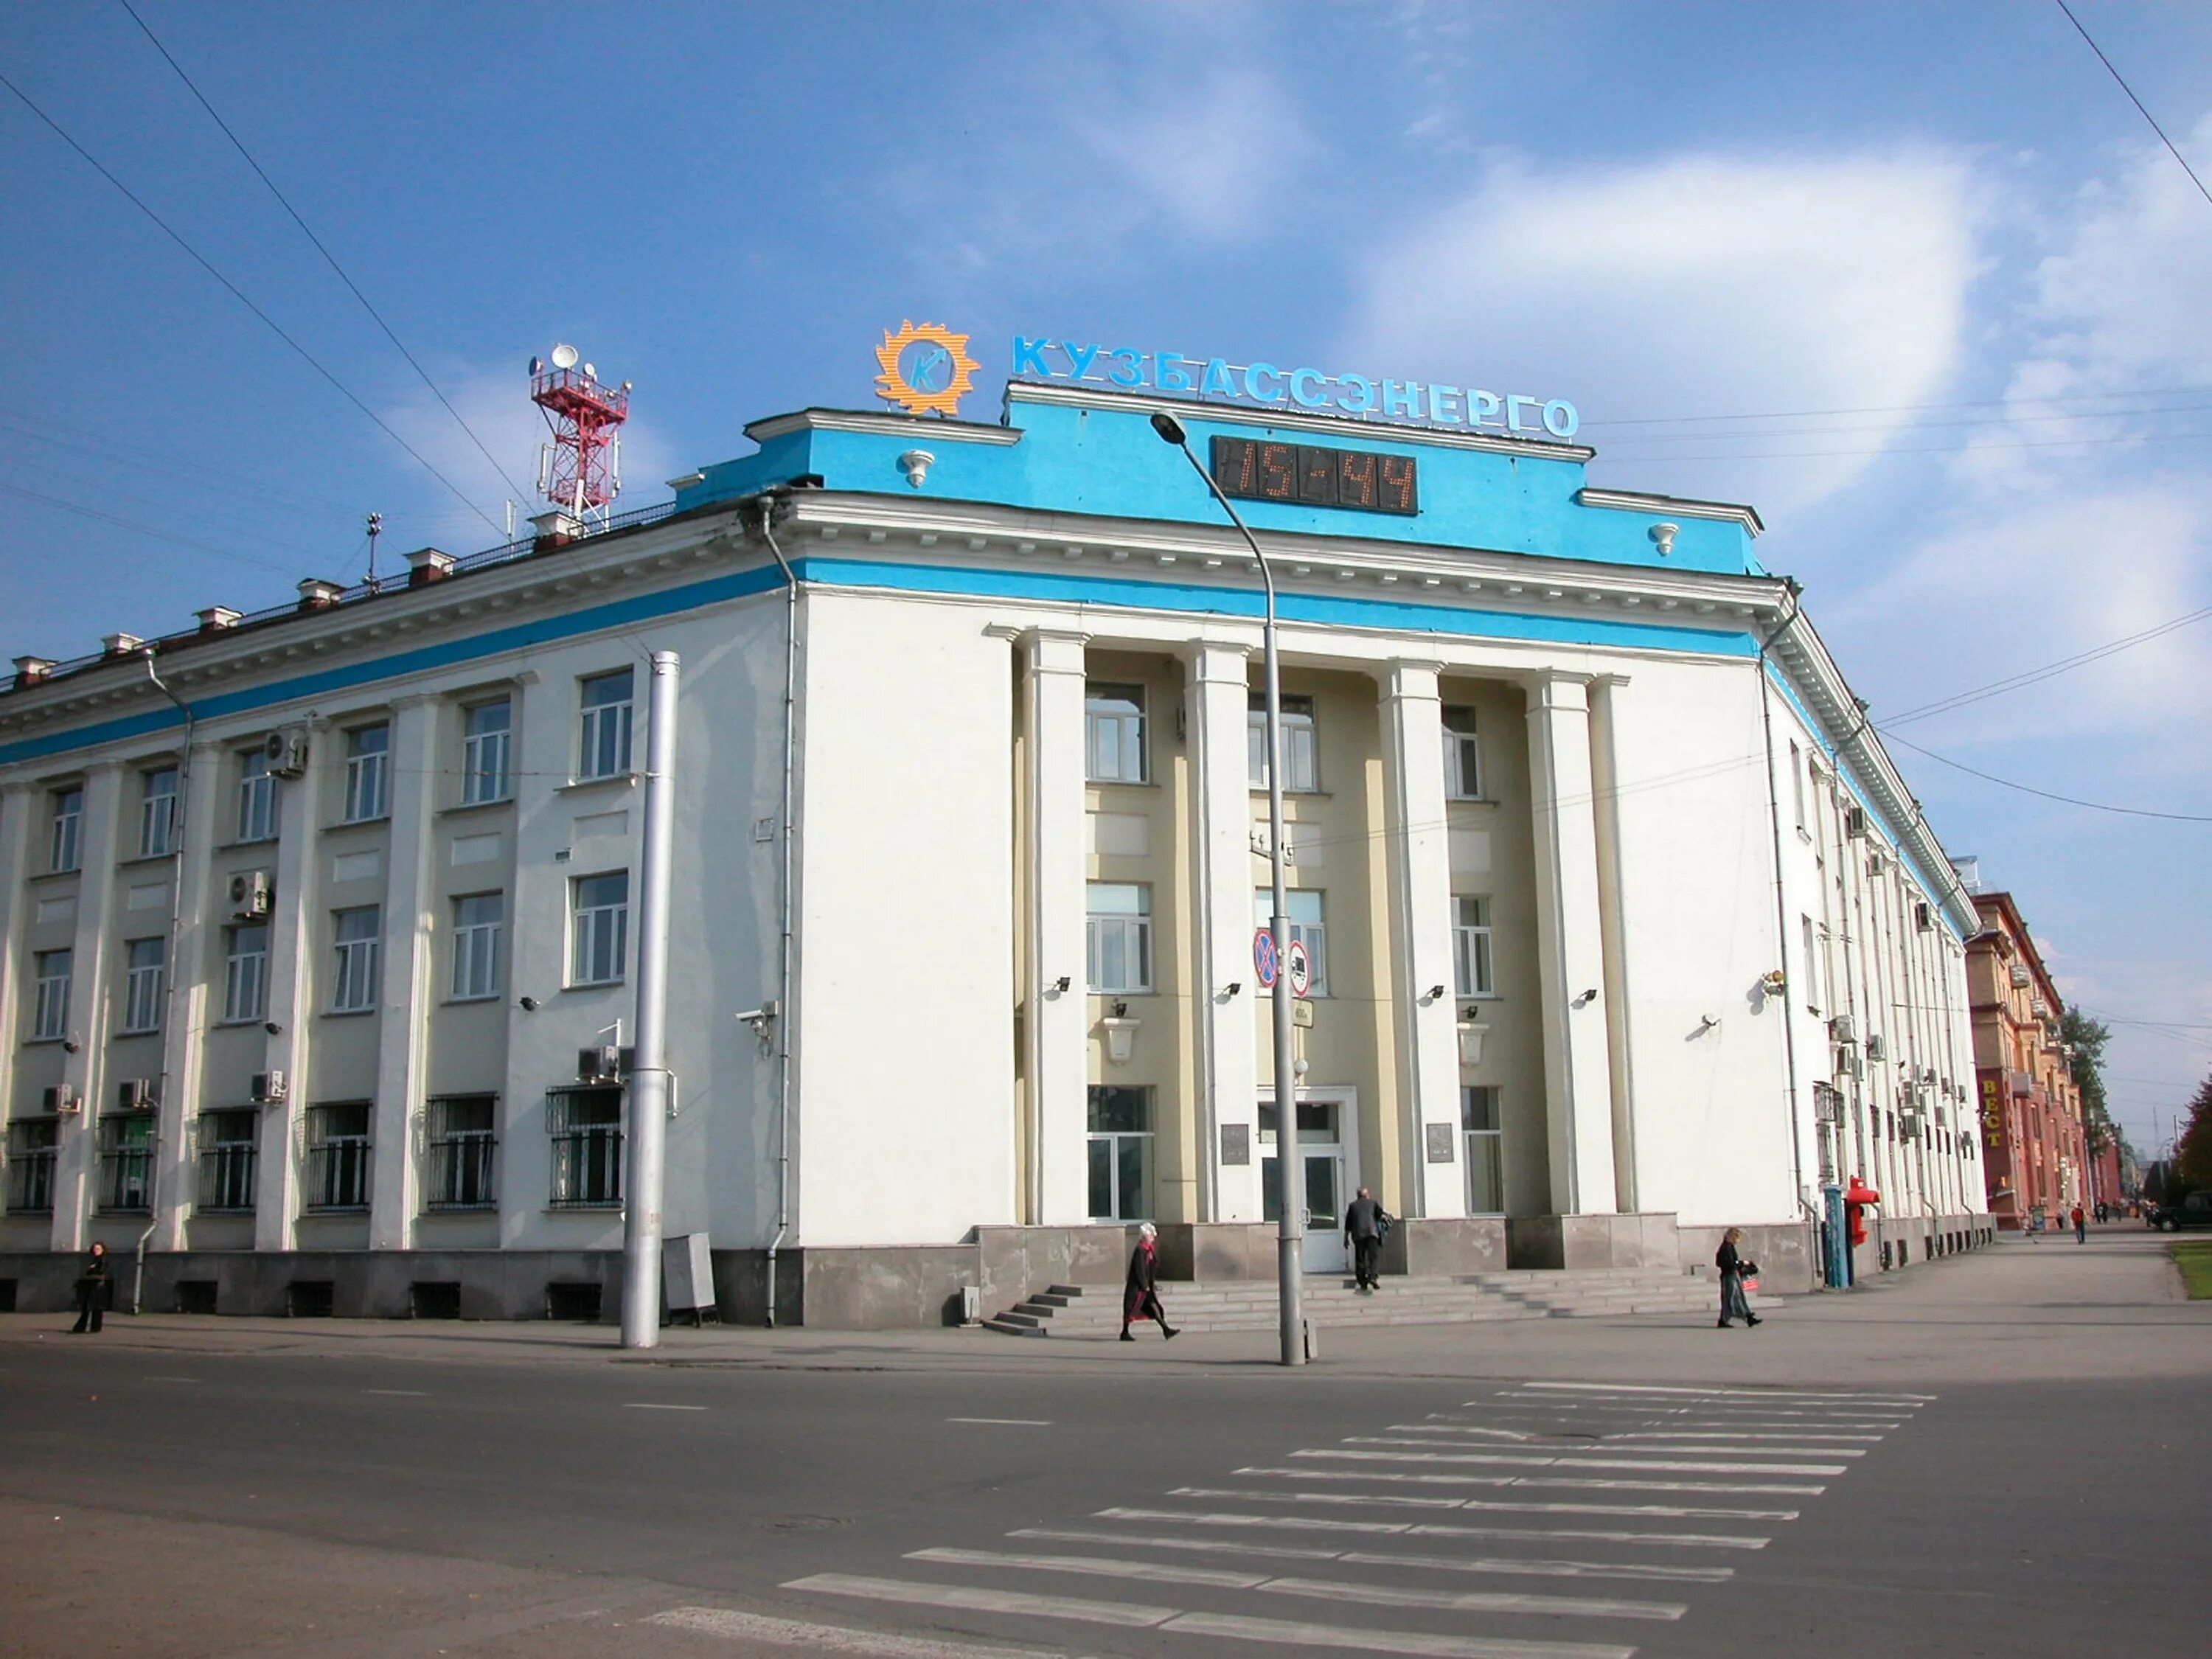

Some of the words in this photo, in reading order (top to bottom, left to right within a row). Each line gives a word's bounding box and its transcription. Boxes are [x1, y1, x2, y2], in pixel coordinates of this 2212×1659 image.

[1012, 335, 1579, 437] КУЗБАССЭНЕРГО
[1239, 442, 1414, 508] 15-44
[1983, 1079, 2000, 1147] ВЕСТ
